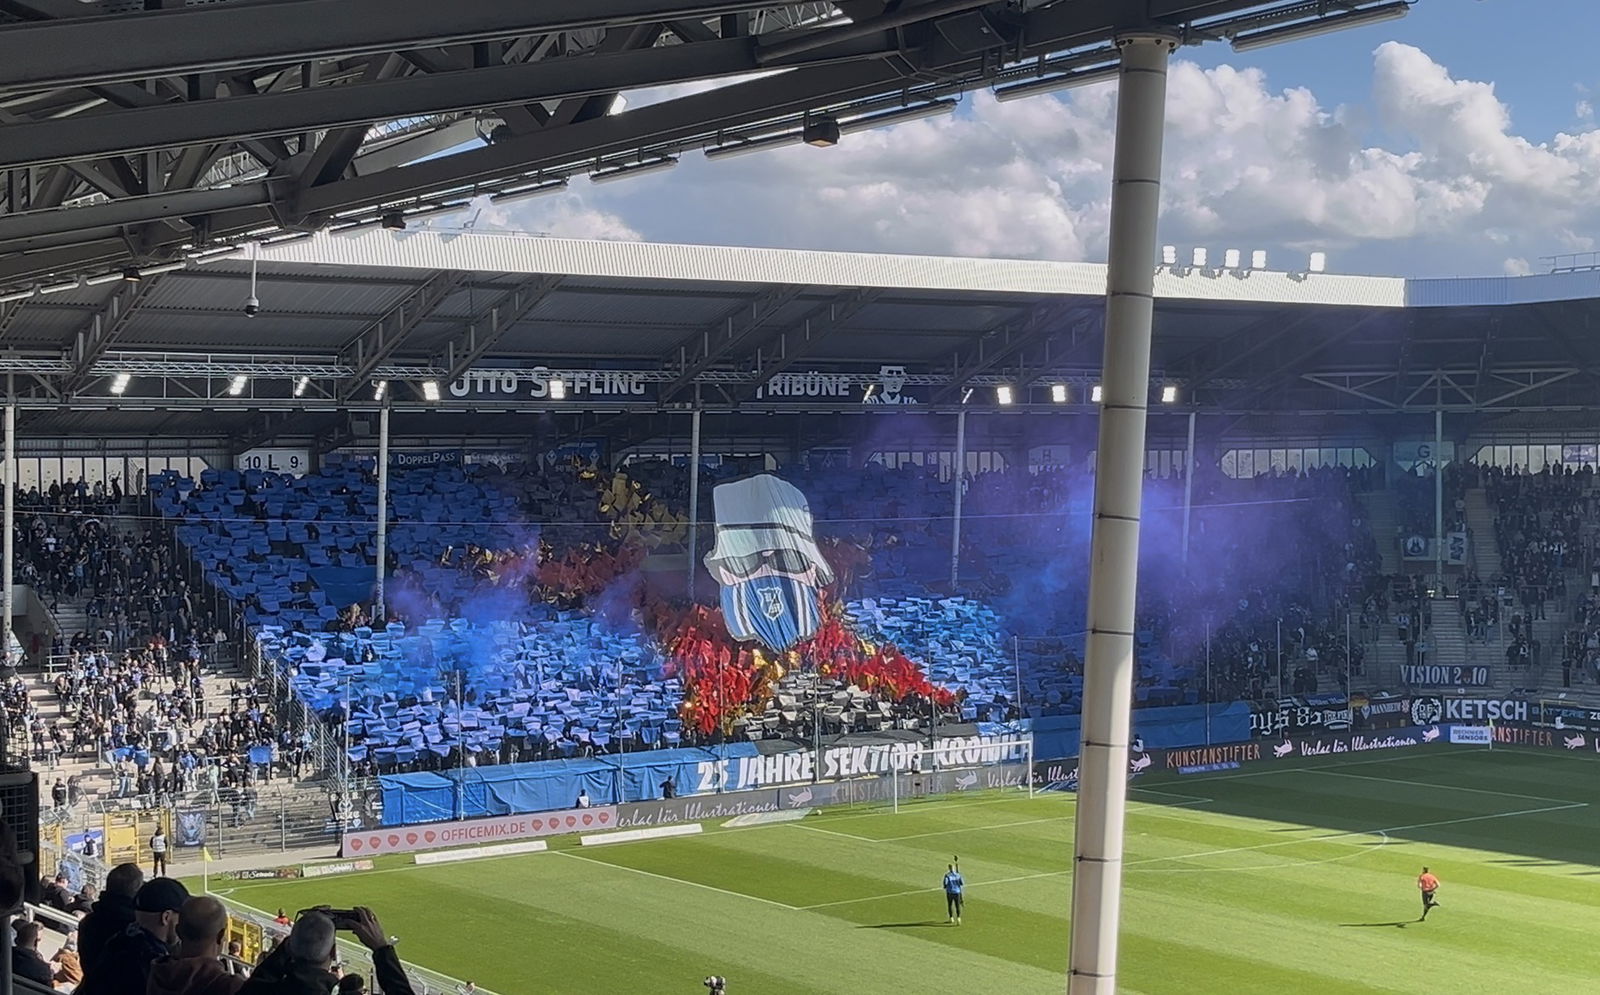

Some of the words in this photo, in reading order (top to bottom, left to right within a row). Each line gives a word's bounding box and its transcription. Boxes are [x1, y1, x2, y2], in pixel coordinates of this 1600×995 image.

[531, 366, 645, 397] SFFLING
[1417, 445, 1430, 458] G
[245, 456, 261, 469] 10
[268, 454, 280, 471] L
[290, 456, 299, 469] 9
[1400, 665, 1450, 684] VISION
[1447, 699, 1527, 720] KETSCH
[1351, 736, 1417, 751] Illustrationen
[697, 760, 728, 791] 25
[736, 750, 815, 789] JAHRE
[824, 741, 923, 777] SEKTION
[684, 802, 780, 821] Illustrationen
[441, 821, 525, 841] OFFICEMIX.DE
